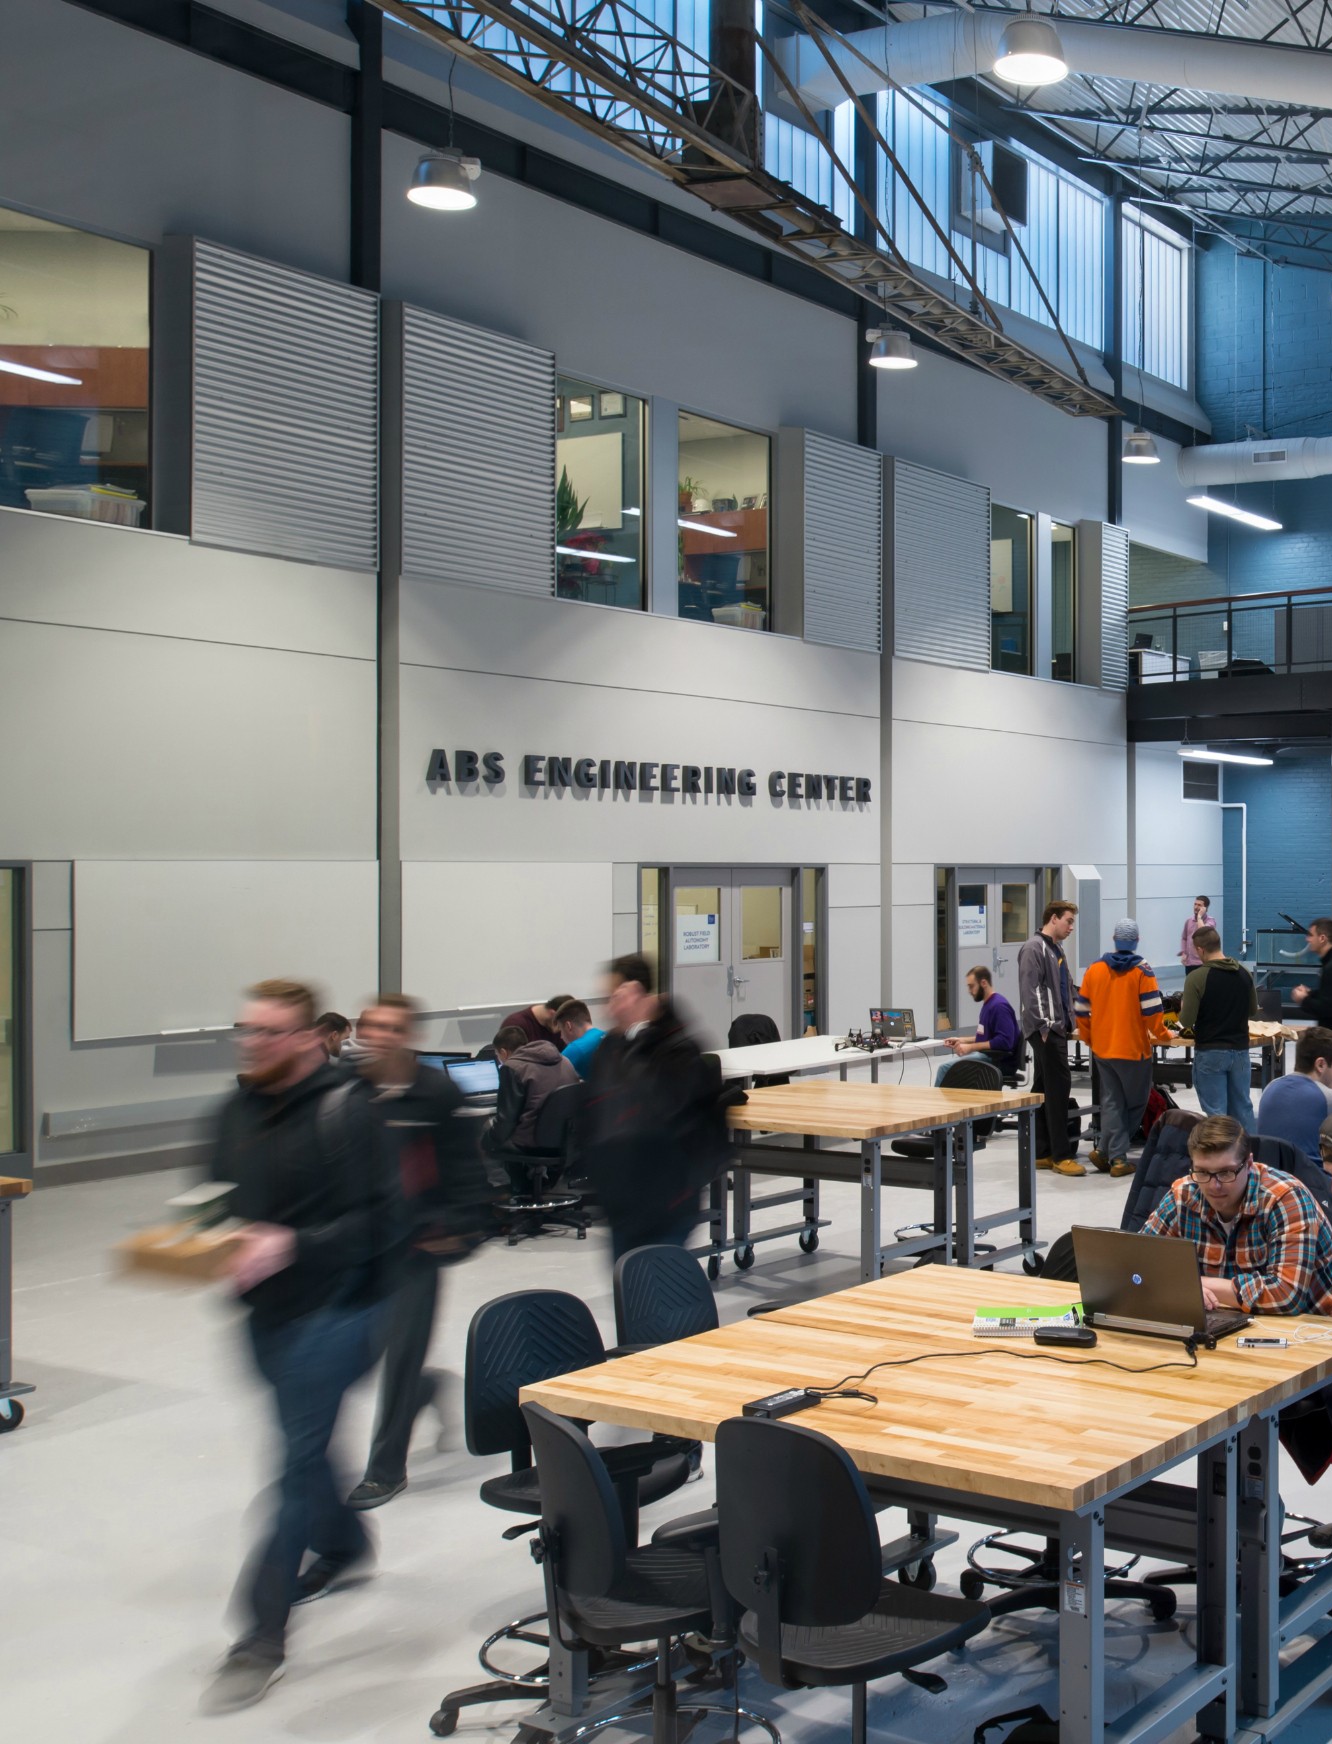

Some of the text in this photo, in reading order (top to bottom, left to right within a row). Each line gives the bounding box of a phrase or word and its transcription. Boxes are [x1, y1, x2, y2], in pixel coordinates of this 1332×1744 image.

[426, 749, 872, 803] ABS ENGINEERING CENTER
